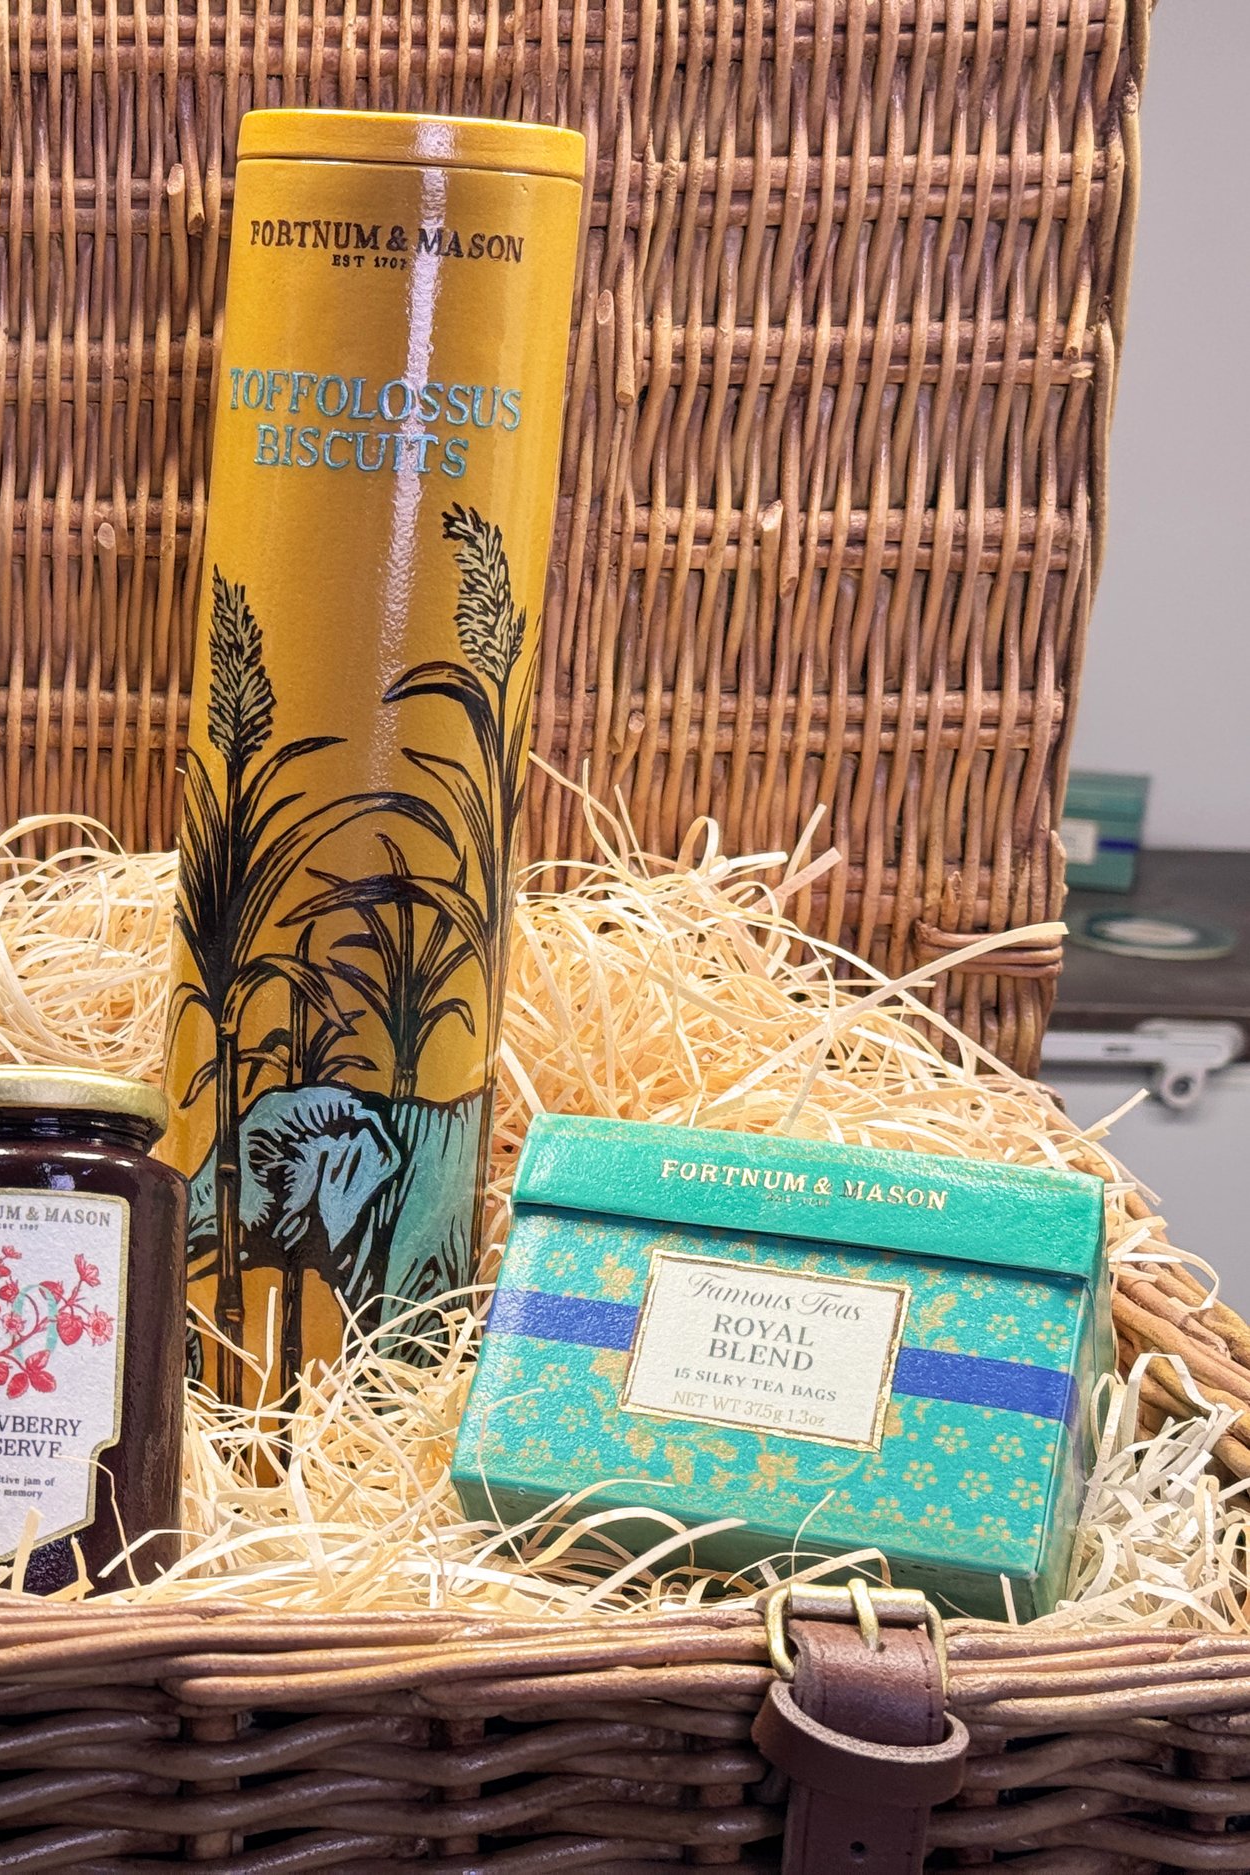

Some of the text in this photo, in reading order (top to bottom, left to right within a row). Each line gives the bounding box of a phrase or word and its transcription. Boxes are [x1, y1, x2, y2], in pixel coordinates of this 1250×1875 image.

[250, 220, 525, 263] FORTNUM & MASON
[331, 254, 407, 270] EST 1707
[230, 367, 523, 432] TOFFOLOSSUS
[252, 423, 470, 479] BISCUITS
[660, 1159, 948, 1211] FORTNUM & MASON
[25, 1206, 40, 1222] &
[45, 1208, 111, 1227] MASON
[687, 1272, 865, 1321] Famous Teas
[712, 1313, 814, 1347] ROYAL
[708, 1338, 813, 1371] BLEND
[674, 1367, 837, 1401] 15 SILKY TEA BAGS
[673, 1390, 708, 1406] NET
[712, 1395, 741, 1413] WT
[787, 1408, 826, 1427] 1.3oz
[3, 1489, 43, 1500] memory
[24, 1476, 41, 1487] jam
[45, 1477, 56, 1487] of
